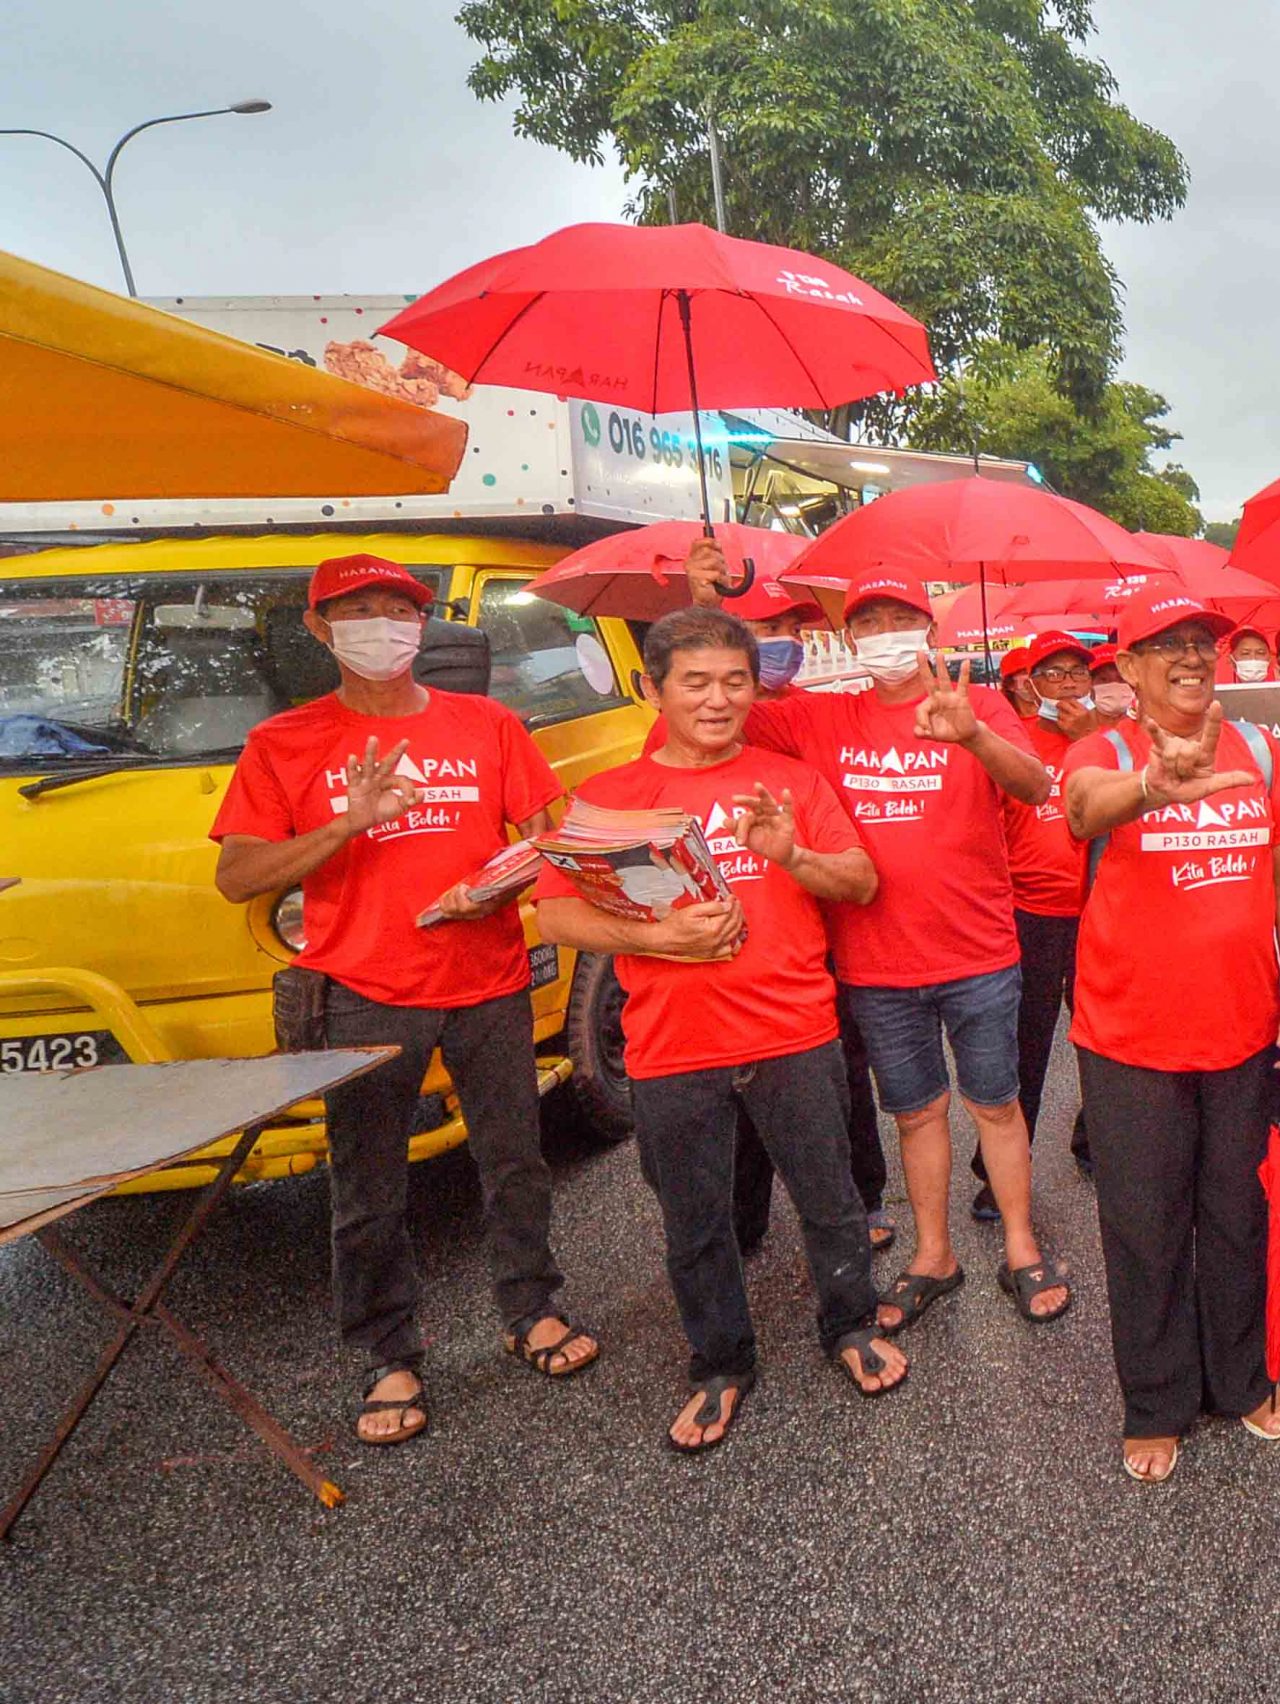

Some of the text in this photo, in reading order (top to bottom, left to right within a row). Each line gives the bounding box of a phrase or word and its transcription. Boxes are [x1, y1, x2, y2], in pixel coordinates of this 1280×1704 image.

[608, 410, 645, 460] 016
[650, 428, 683, 468] 965
[325, 753, 478, 789] HAPAN
[840, 746, 948, 775] HARAPAN
[427, 789, 462, 800] SAH
[849, 777, 937, 790] P130 RASAH
[1163, 831, 1259, 848] P130 RASAH
[1172, 862, 1204, 887] Kita
[1, 1036, 98, 1073] 5423
